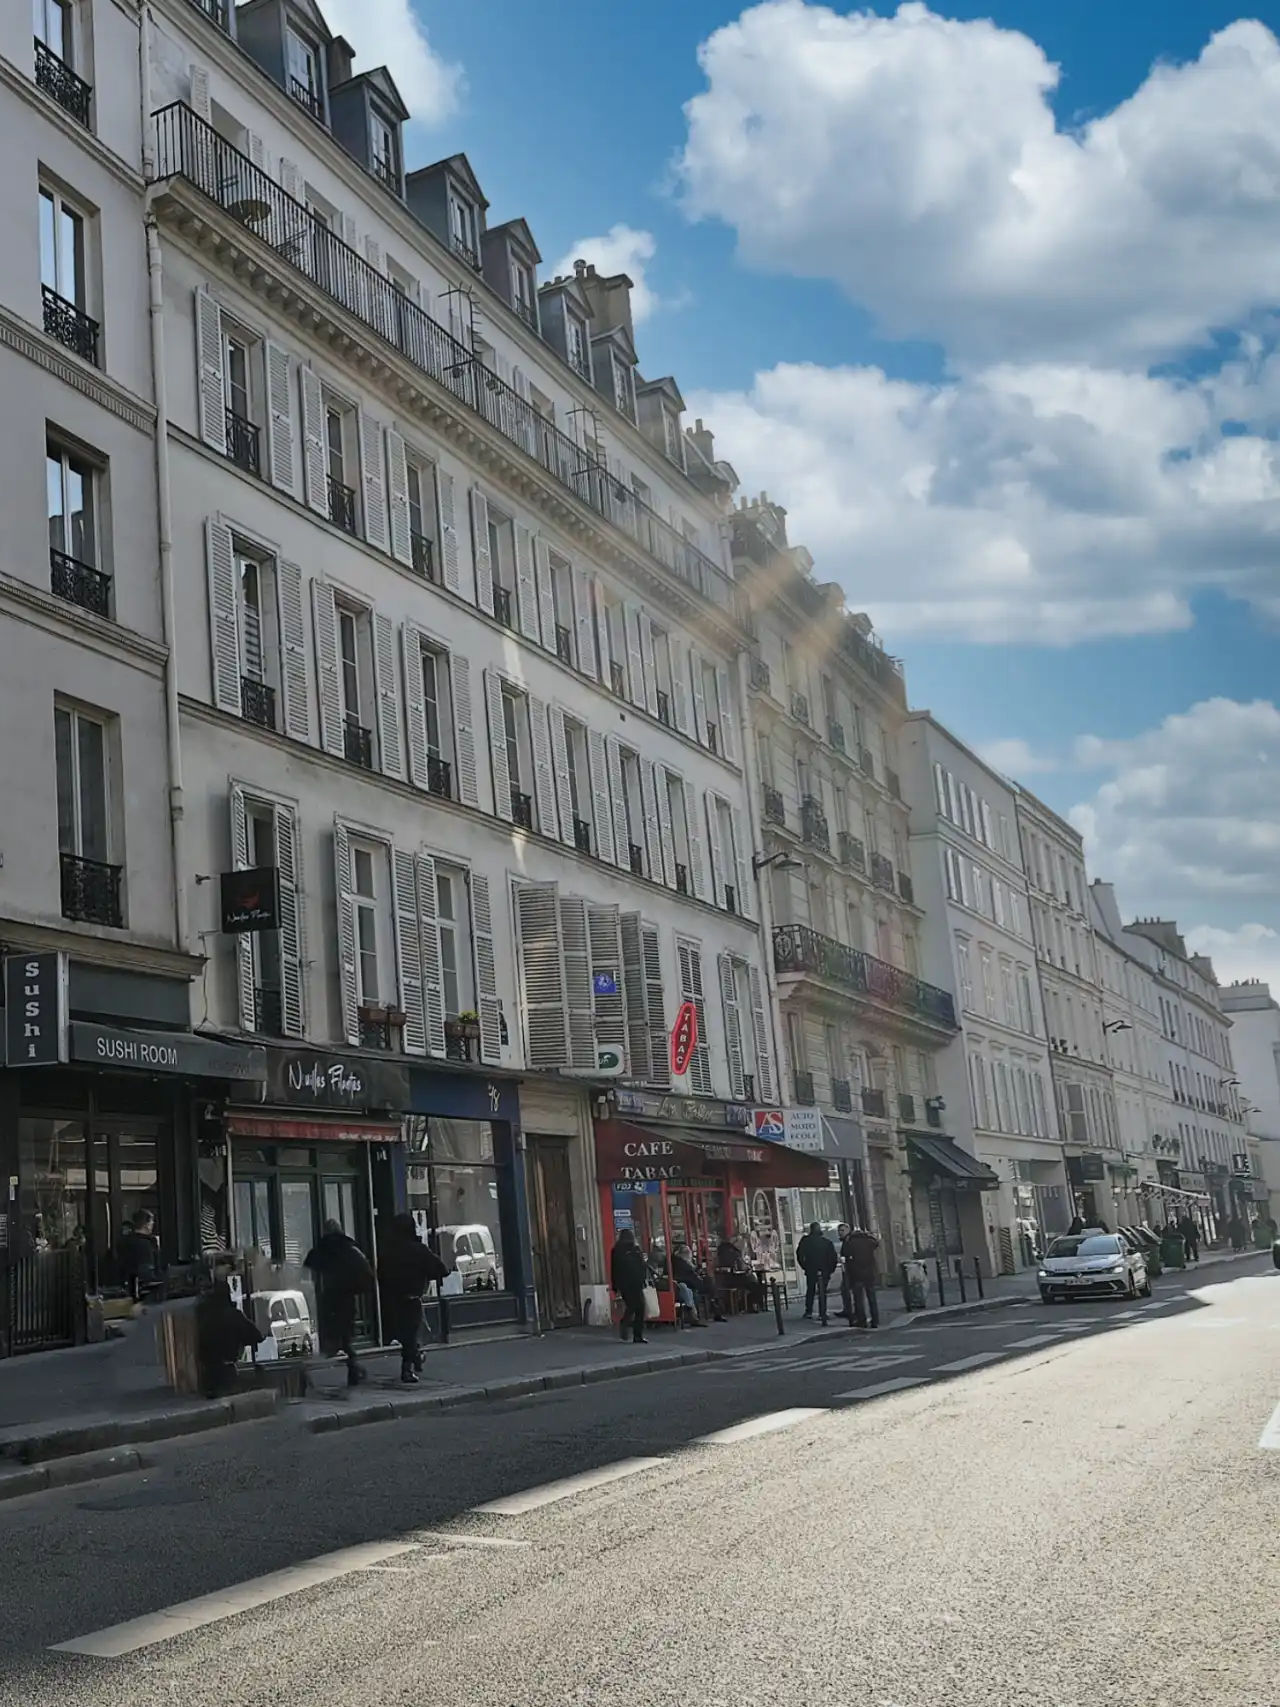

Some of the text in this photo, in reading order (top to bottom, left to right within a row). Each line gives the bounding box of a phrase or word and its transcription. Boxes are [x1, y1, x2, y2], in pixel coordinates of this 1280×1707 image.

[676, 1013, 690, 1064] TABAC
[96, 1036, 179, 1066] SUSHI ROOM
[790, 1112, 815, 1120] AUTO
[624, 1141, 674, 1157] CAFE
[620, 1165, 681, 1180] TABAC
